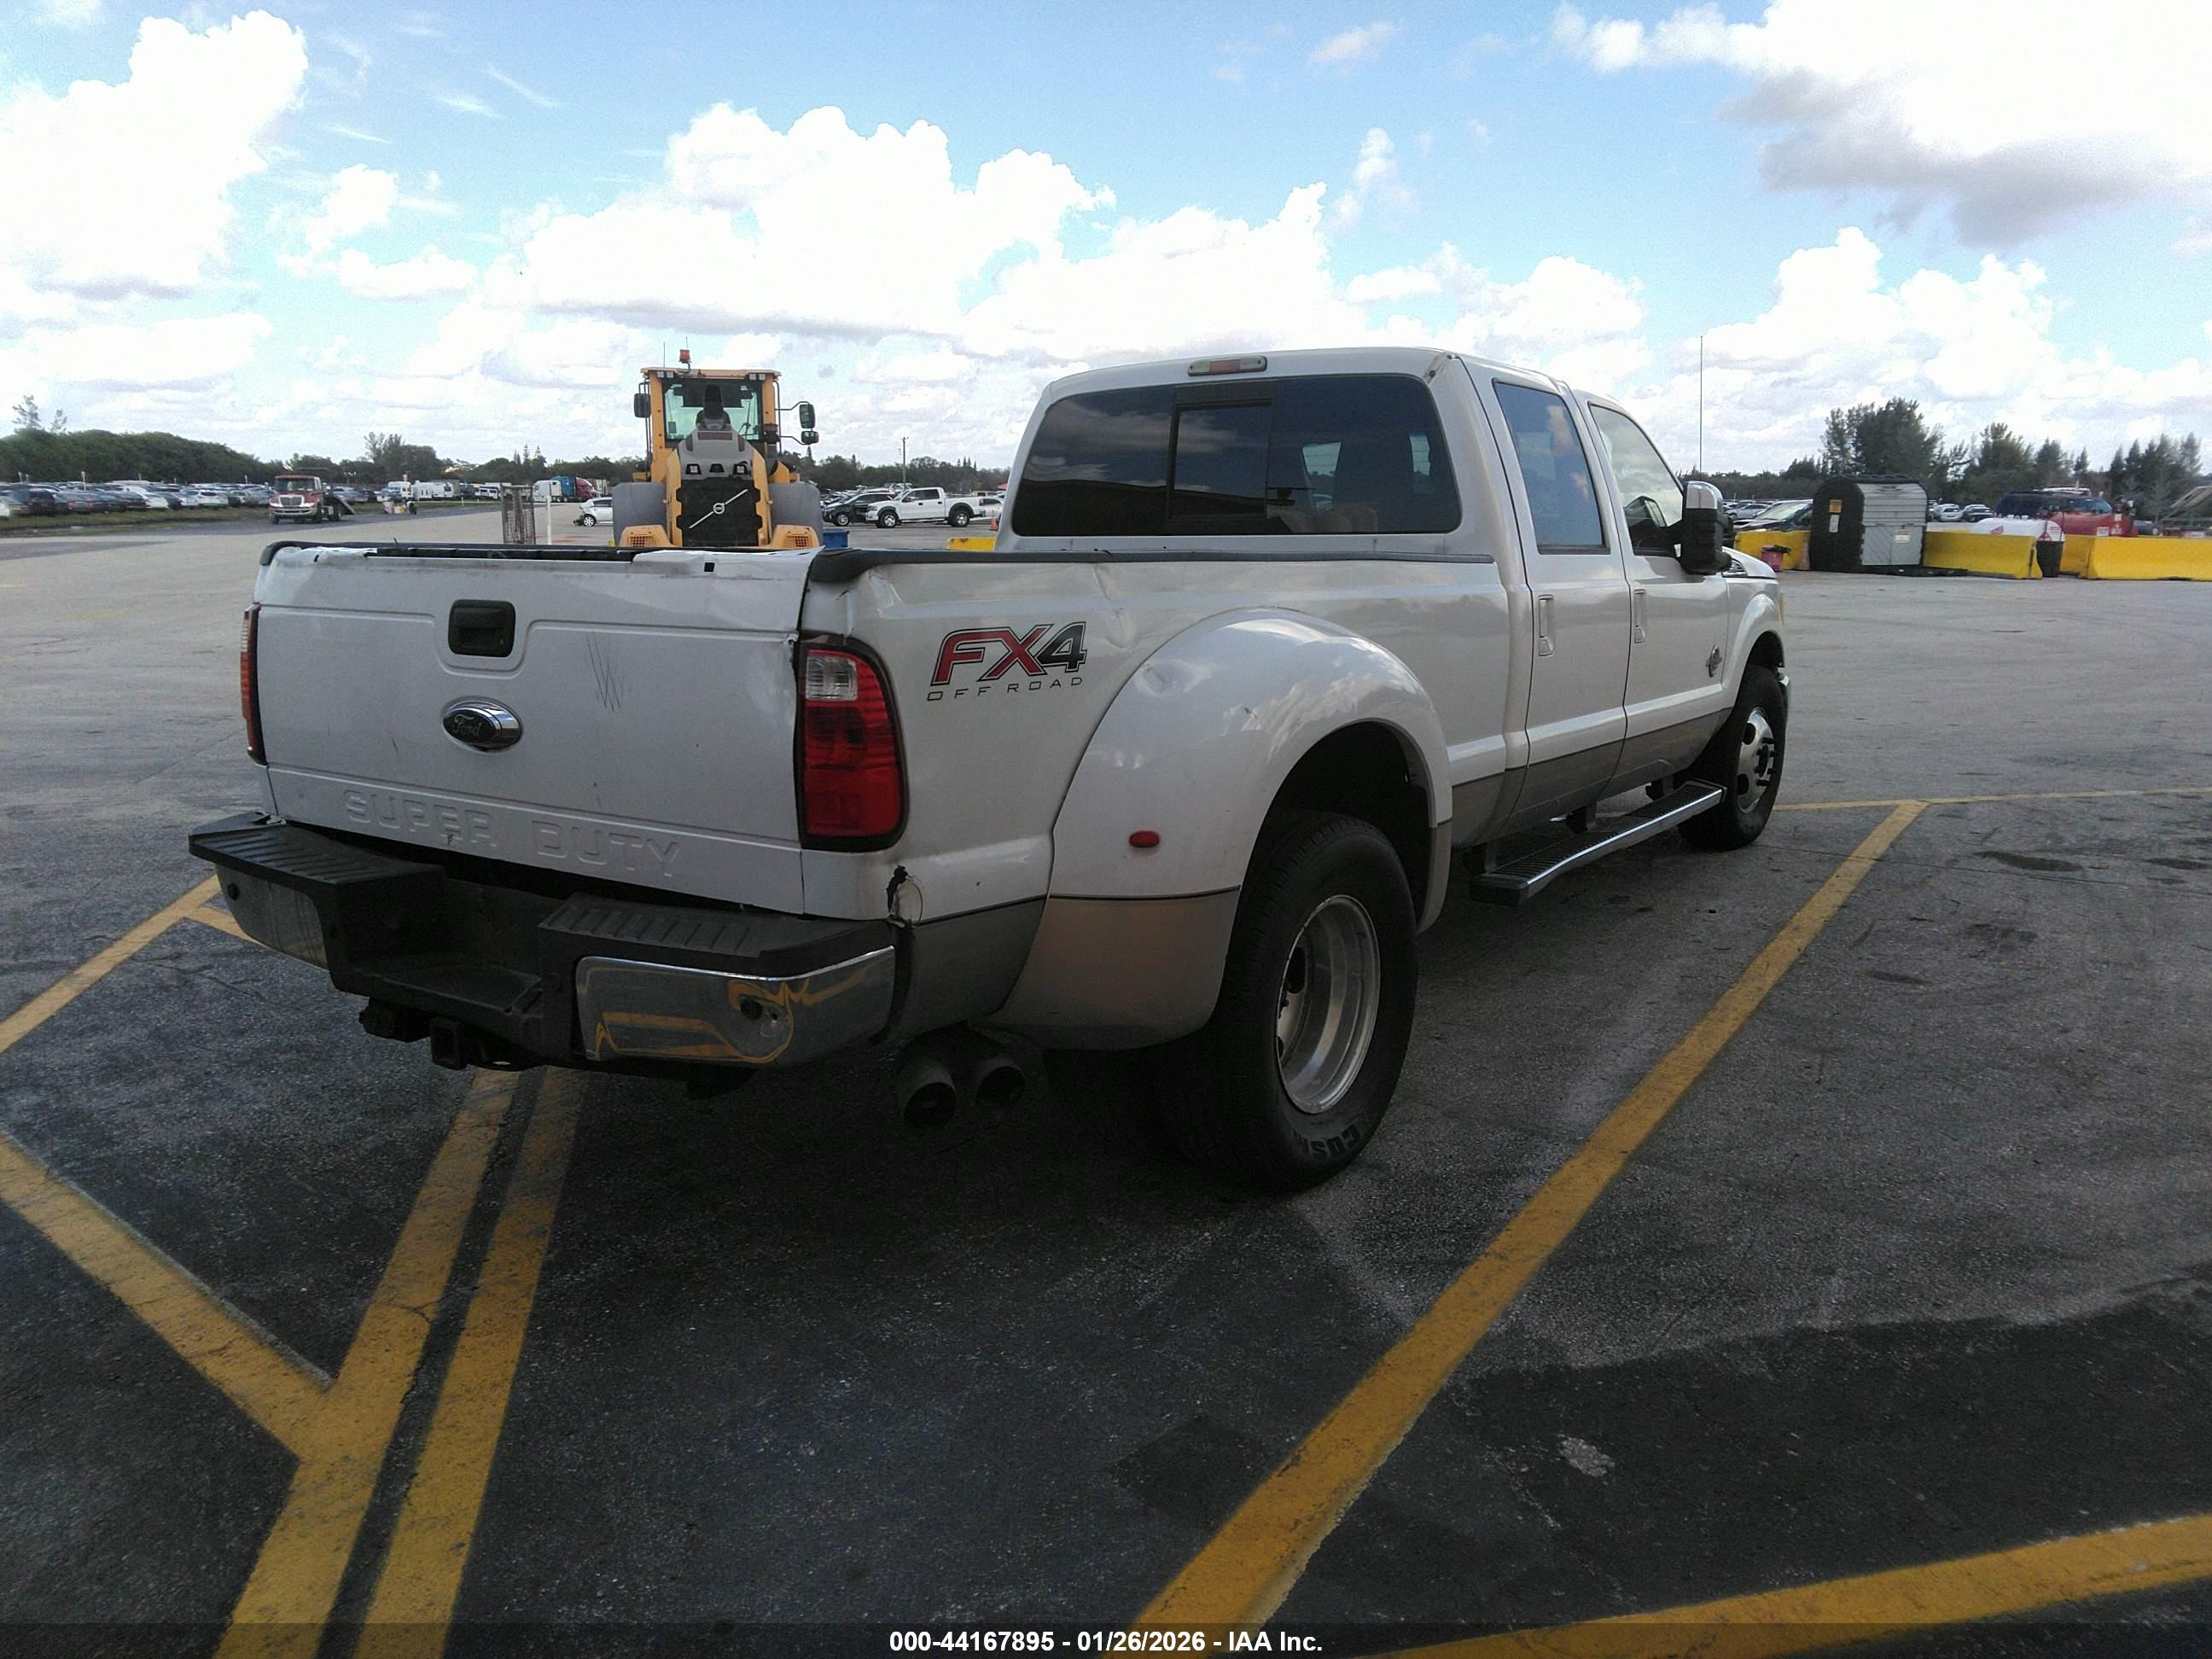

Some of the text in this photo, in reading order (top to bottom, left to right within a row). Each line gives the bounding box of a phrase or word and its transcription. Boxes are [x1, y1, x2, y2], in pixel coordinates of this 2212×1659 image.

[930, 621, 1087, 686] FX4
[927, 677, 1083, 701] OFF ROAD
[451, 713, 483, 737] Ford
[343, 789, 680, 877] SUPER DUTY
